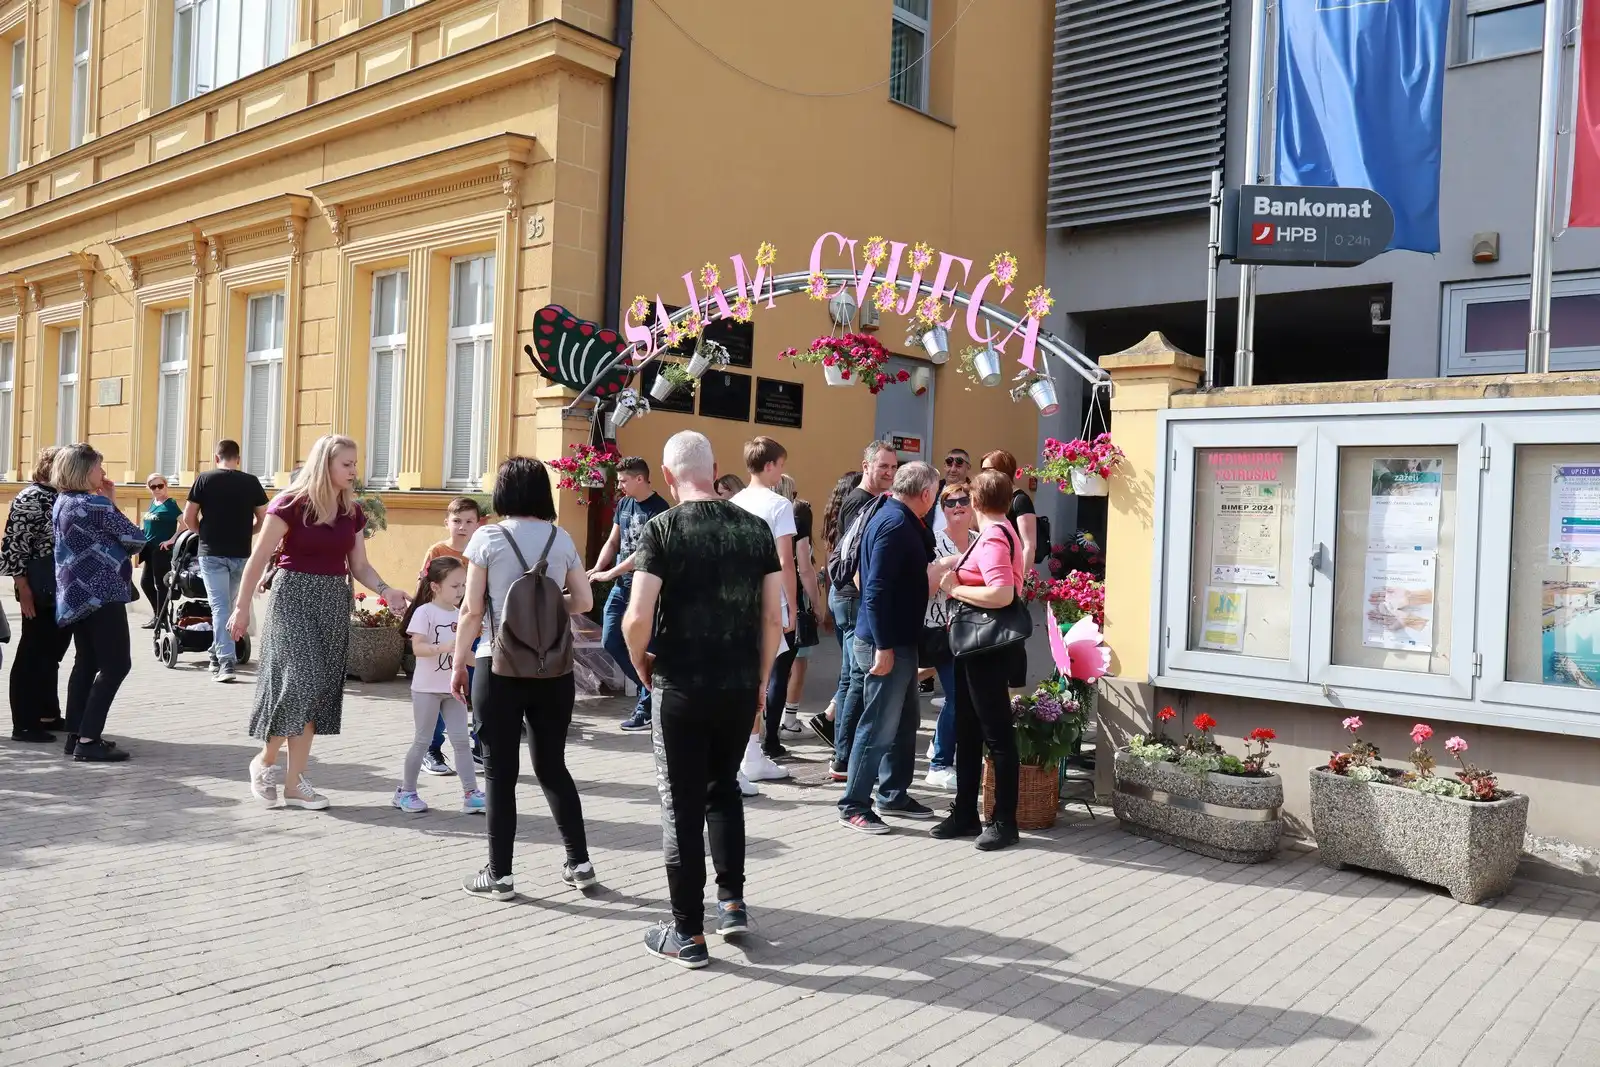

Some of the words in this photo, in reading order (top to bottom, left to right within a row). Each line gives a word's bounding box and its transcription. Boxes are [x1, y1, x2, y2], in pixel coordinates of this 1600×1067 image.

[1253, 196, 1372, 218] Bankomat
[528, 214, 545, 240] 35
[1277, 227, 1317, 243] HPB
[624, 254, 777, 361] SAJAM
